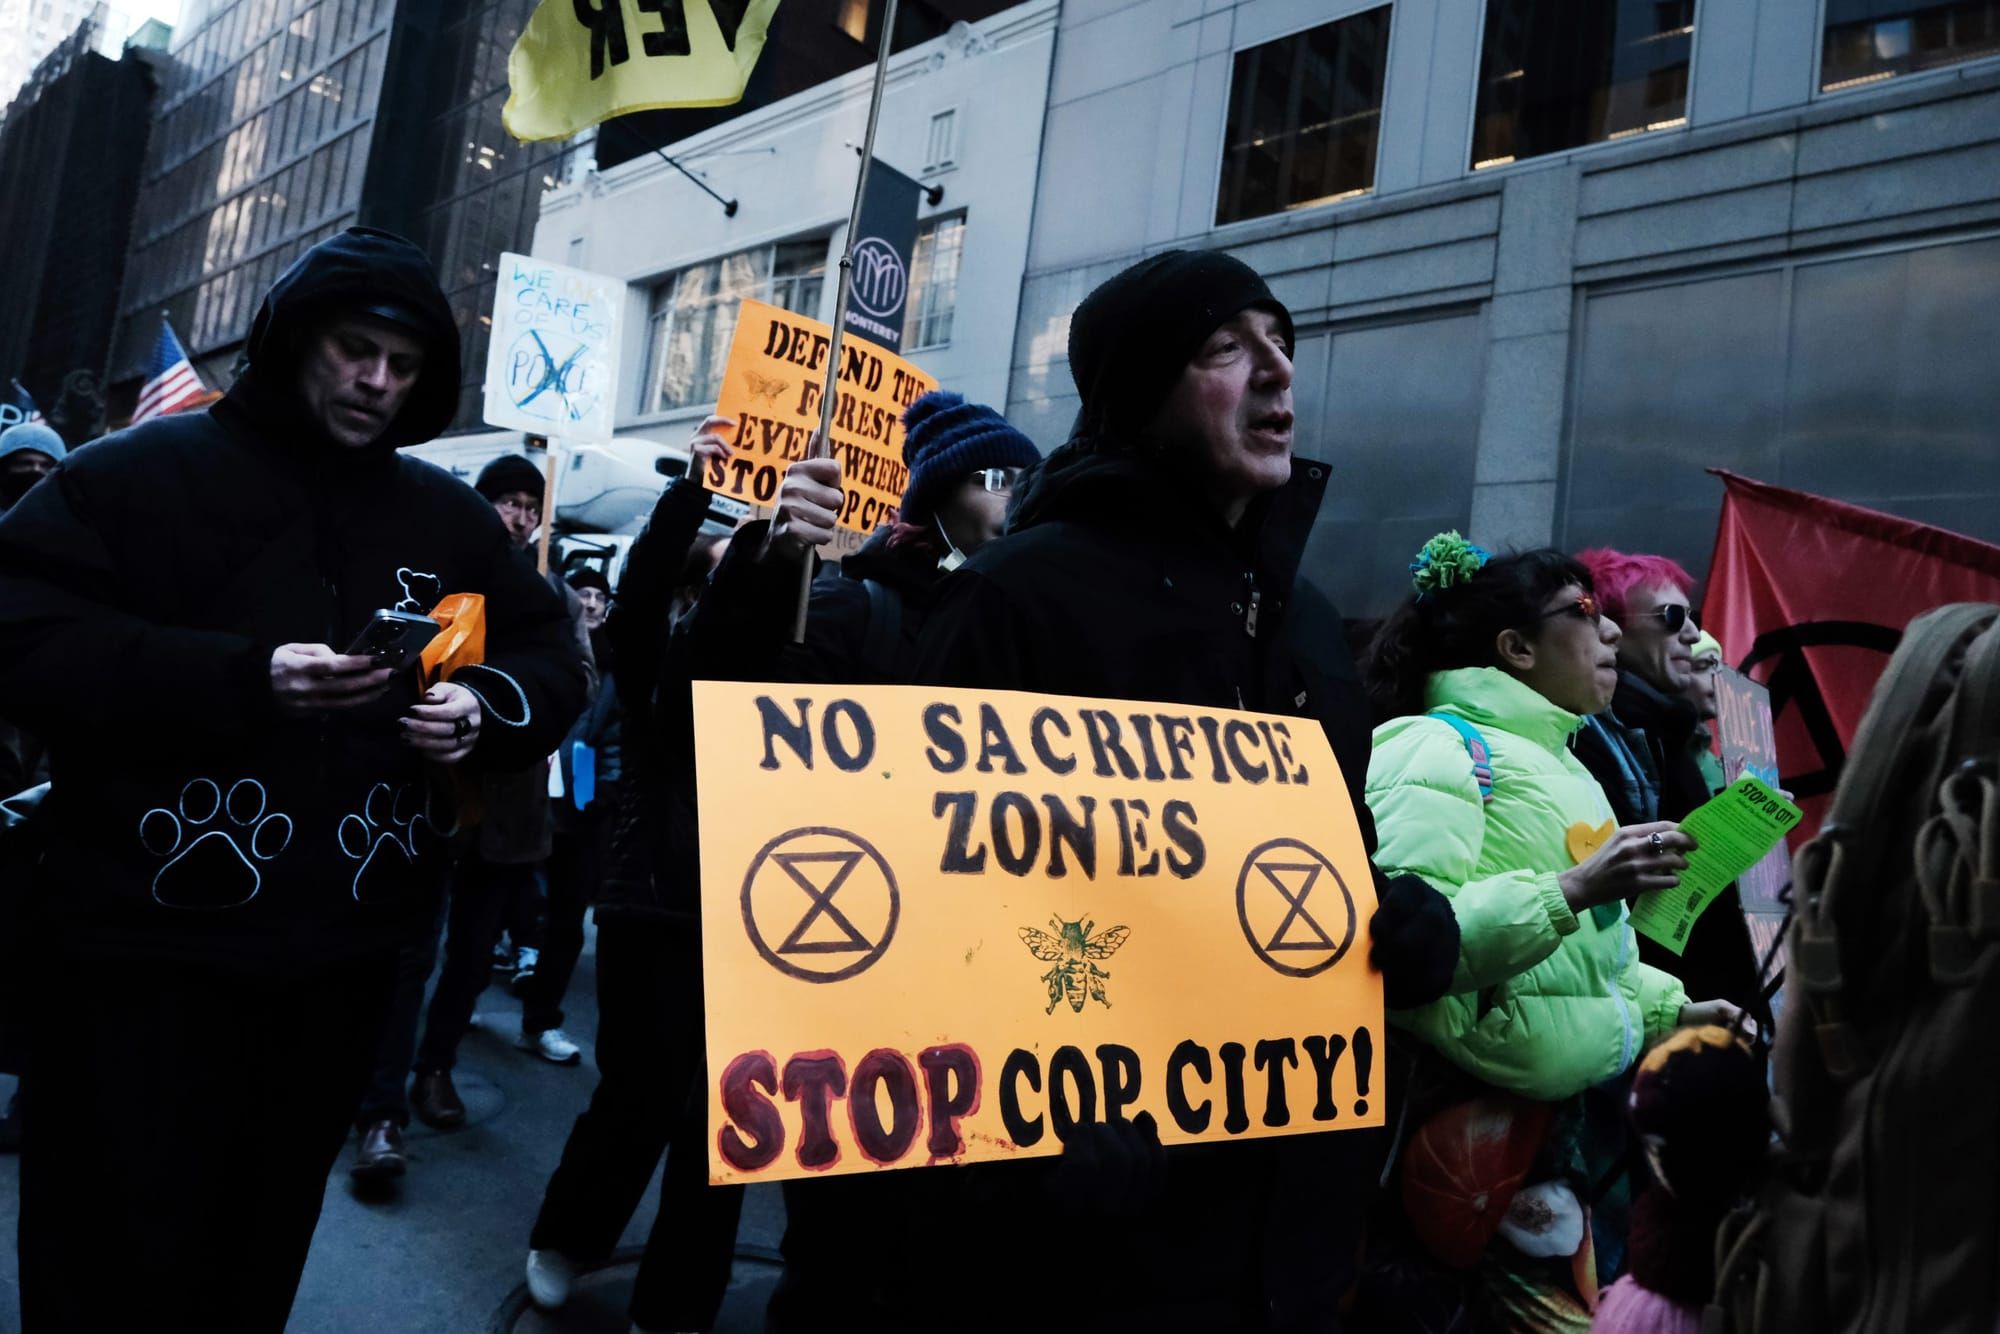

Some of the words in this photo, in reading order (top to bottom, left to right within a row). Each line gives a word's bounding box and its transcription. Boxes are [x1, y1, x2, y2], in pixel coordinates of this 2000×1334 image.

[513, 264, 554, 289] WE
[517, 288, 590, 317] CARE
[709, 455, 785, 501] STO
[861, 496, 899, 532] CIT
[754, 696, 877, 772] NO
[923, 702, 1309, 785] SACRIFICE
[931, 790, 1207, 881] ZONES
[1738, 782, 1768, 805] STOP
[1775, 807, 1796, 826] CITY
[718, 1043, 982, 1172] STOP
[999, 1043, 1142, 1148] COP
[1166, 1026, 1374, 1134] CITY!
